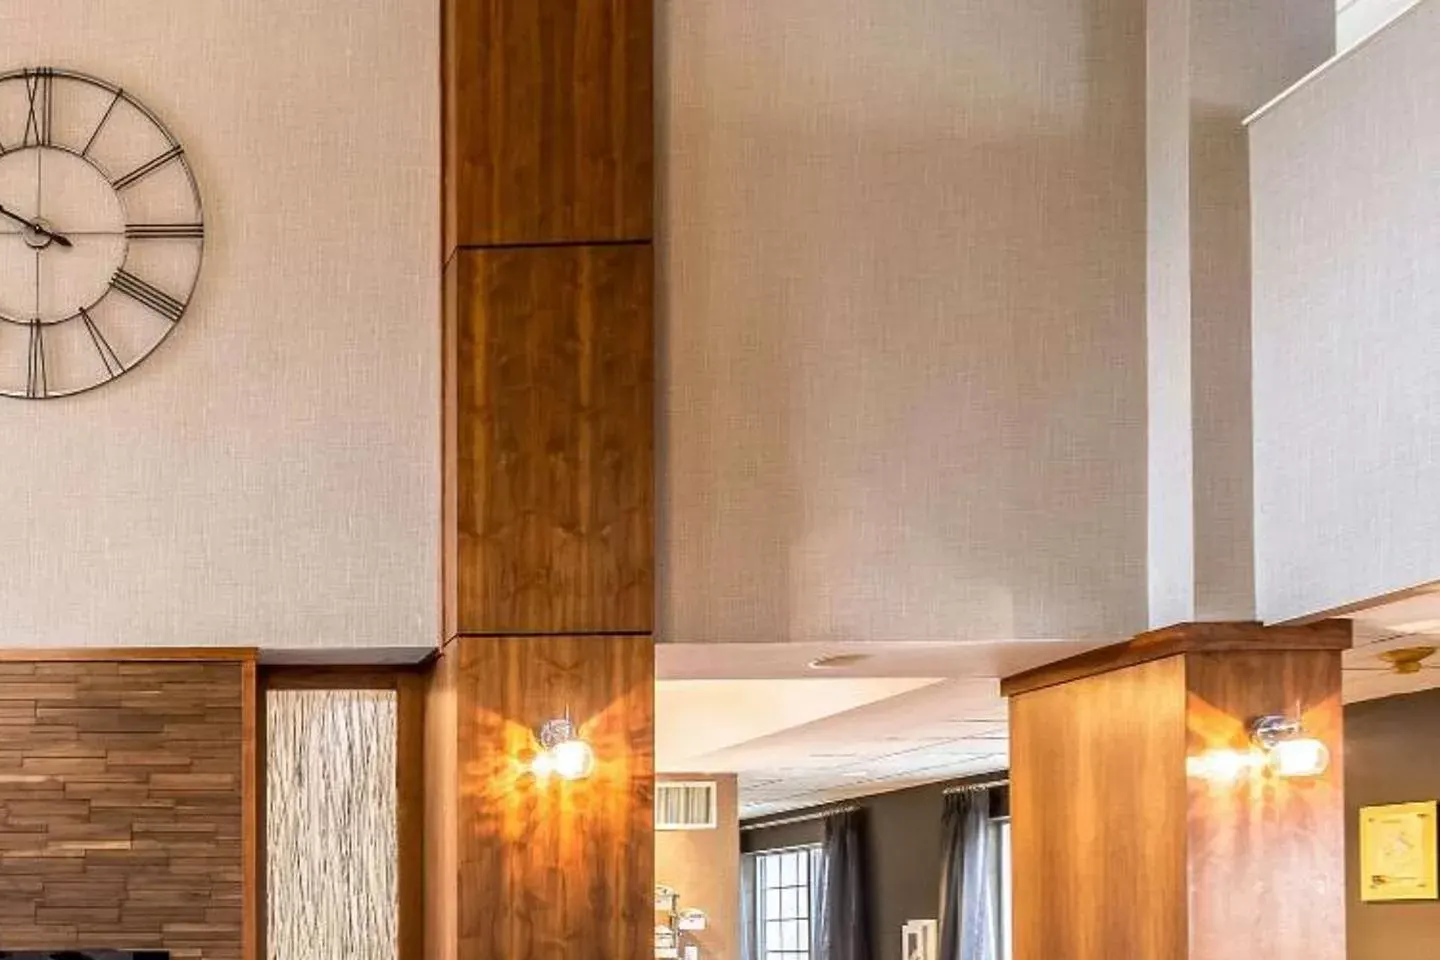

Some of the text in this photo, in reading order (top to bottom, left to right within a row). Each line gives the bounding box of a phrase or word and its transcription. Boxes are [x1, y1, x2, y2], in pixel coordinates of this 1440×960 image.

[23, 67, 53, 147] XII
[81, 87, 124, 158] I
[111, 143, 185, 191] II
[124, 223, 205, 239] III
[26, 318, 48, 399] VI
[78, 305, 127, 380] V
